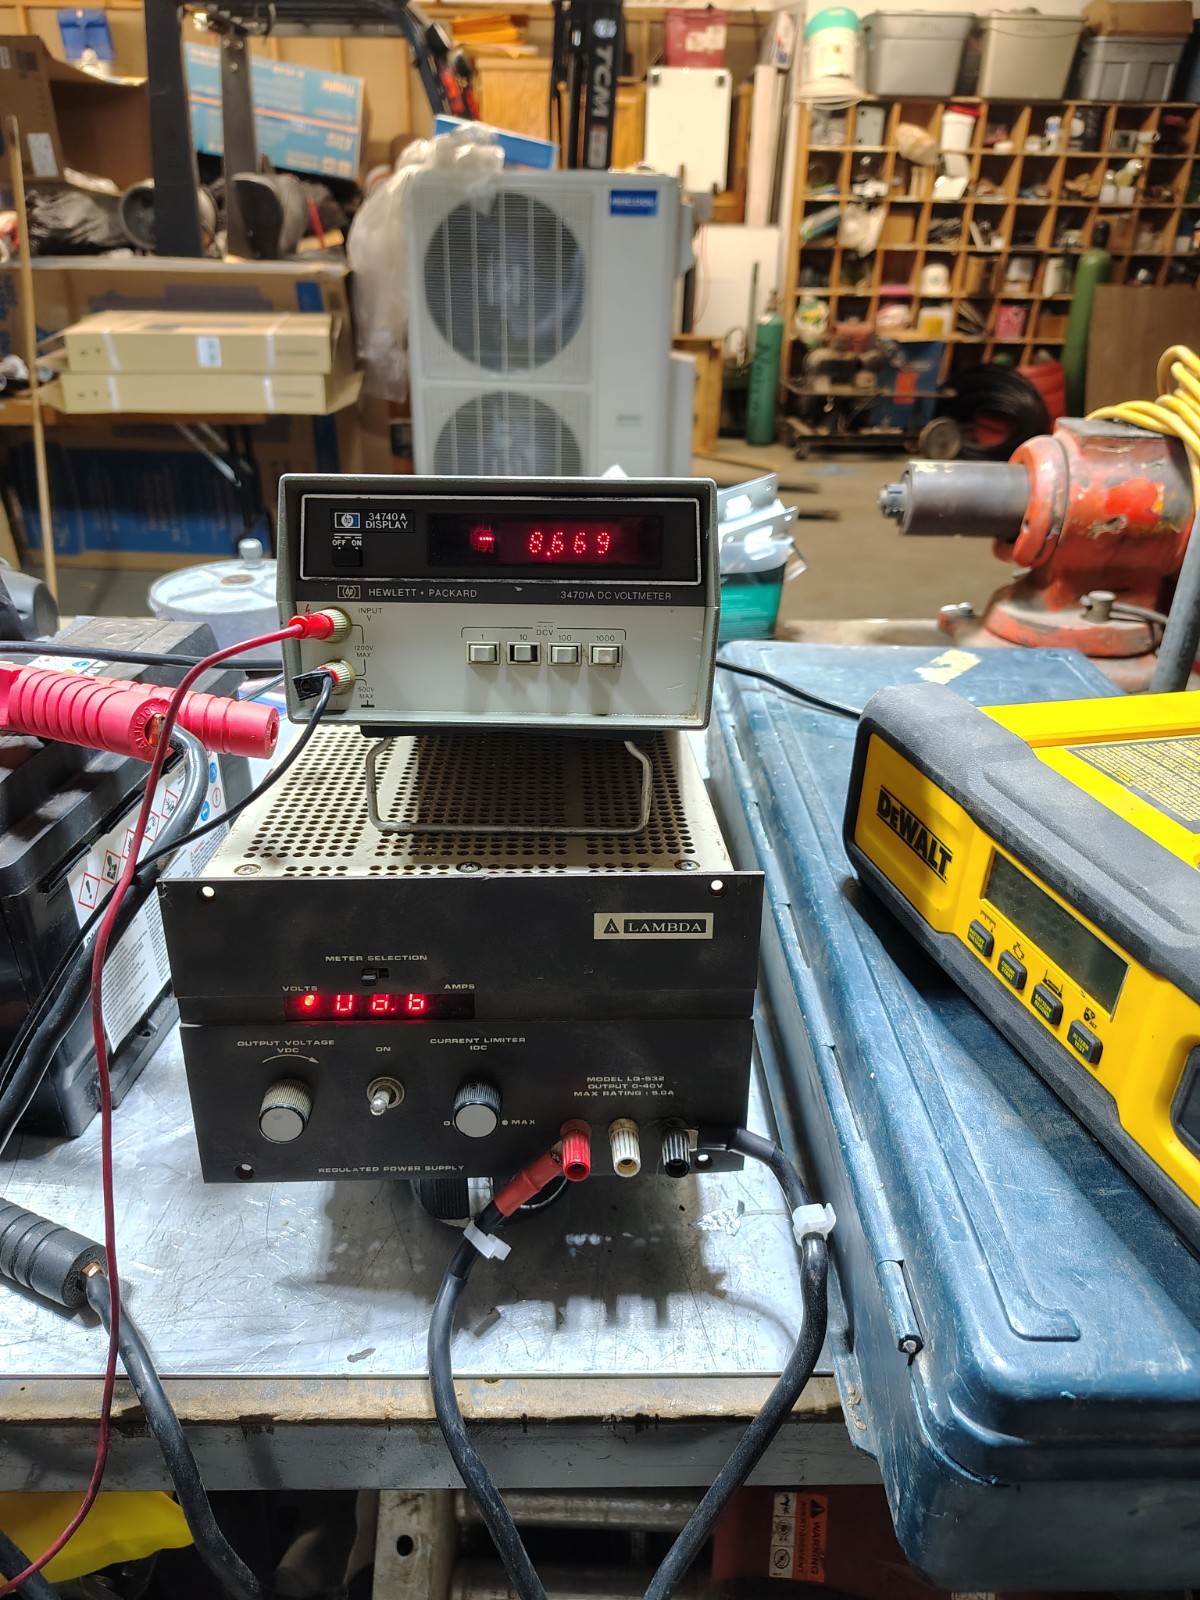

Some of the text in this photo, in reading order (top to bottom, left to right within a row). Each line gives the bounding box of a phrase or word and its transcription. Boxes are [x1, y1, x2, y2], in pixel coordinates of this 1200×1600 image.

[365, 520, 408, 529] DISPLAY
[351, 539, 362, 547] ON
[368, 588, 478, 598] HEWLETT PACKARD
[560, 590, 672, 601] 34701A DC VOLTMETER
[519, 633, 528, 641] 10
[536, 628, 554, 637] DCV
[558, 634, 572, 642] 100
[595, 634, 615, 642] 1000
[628, 921, 704, 932] LAMBDA
[810, 1521, 821, 1575] WARNING
